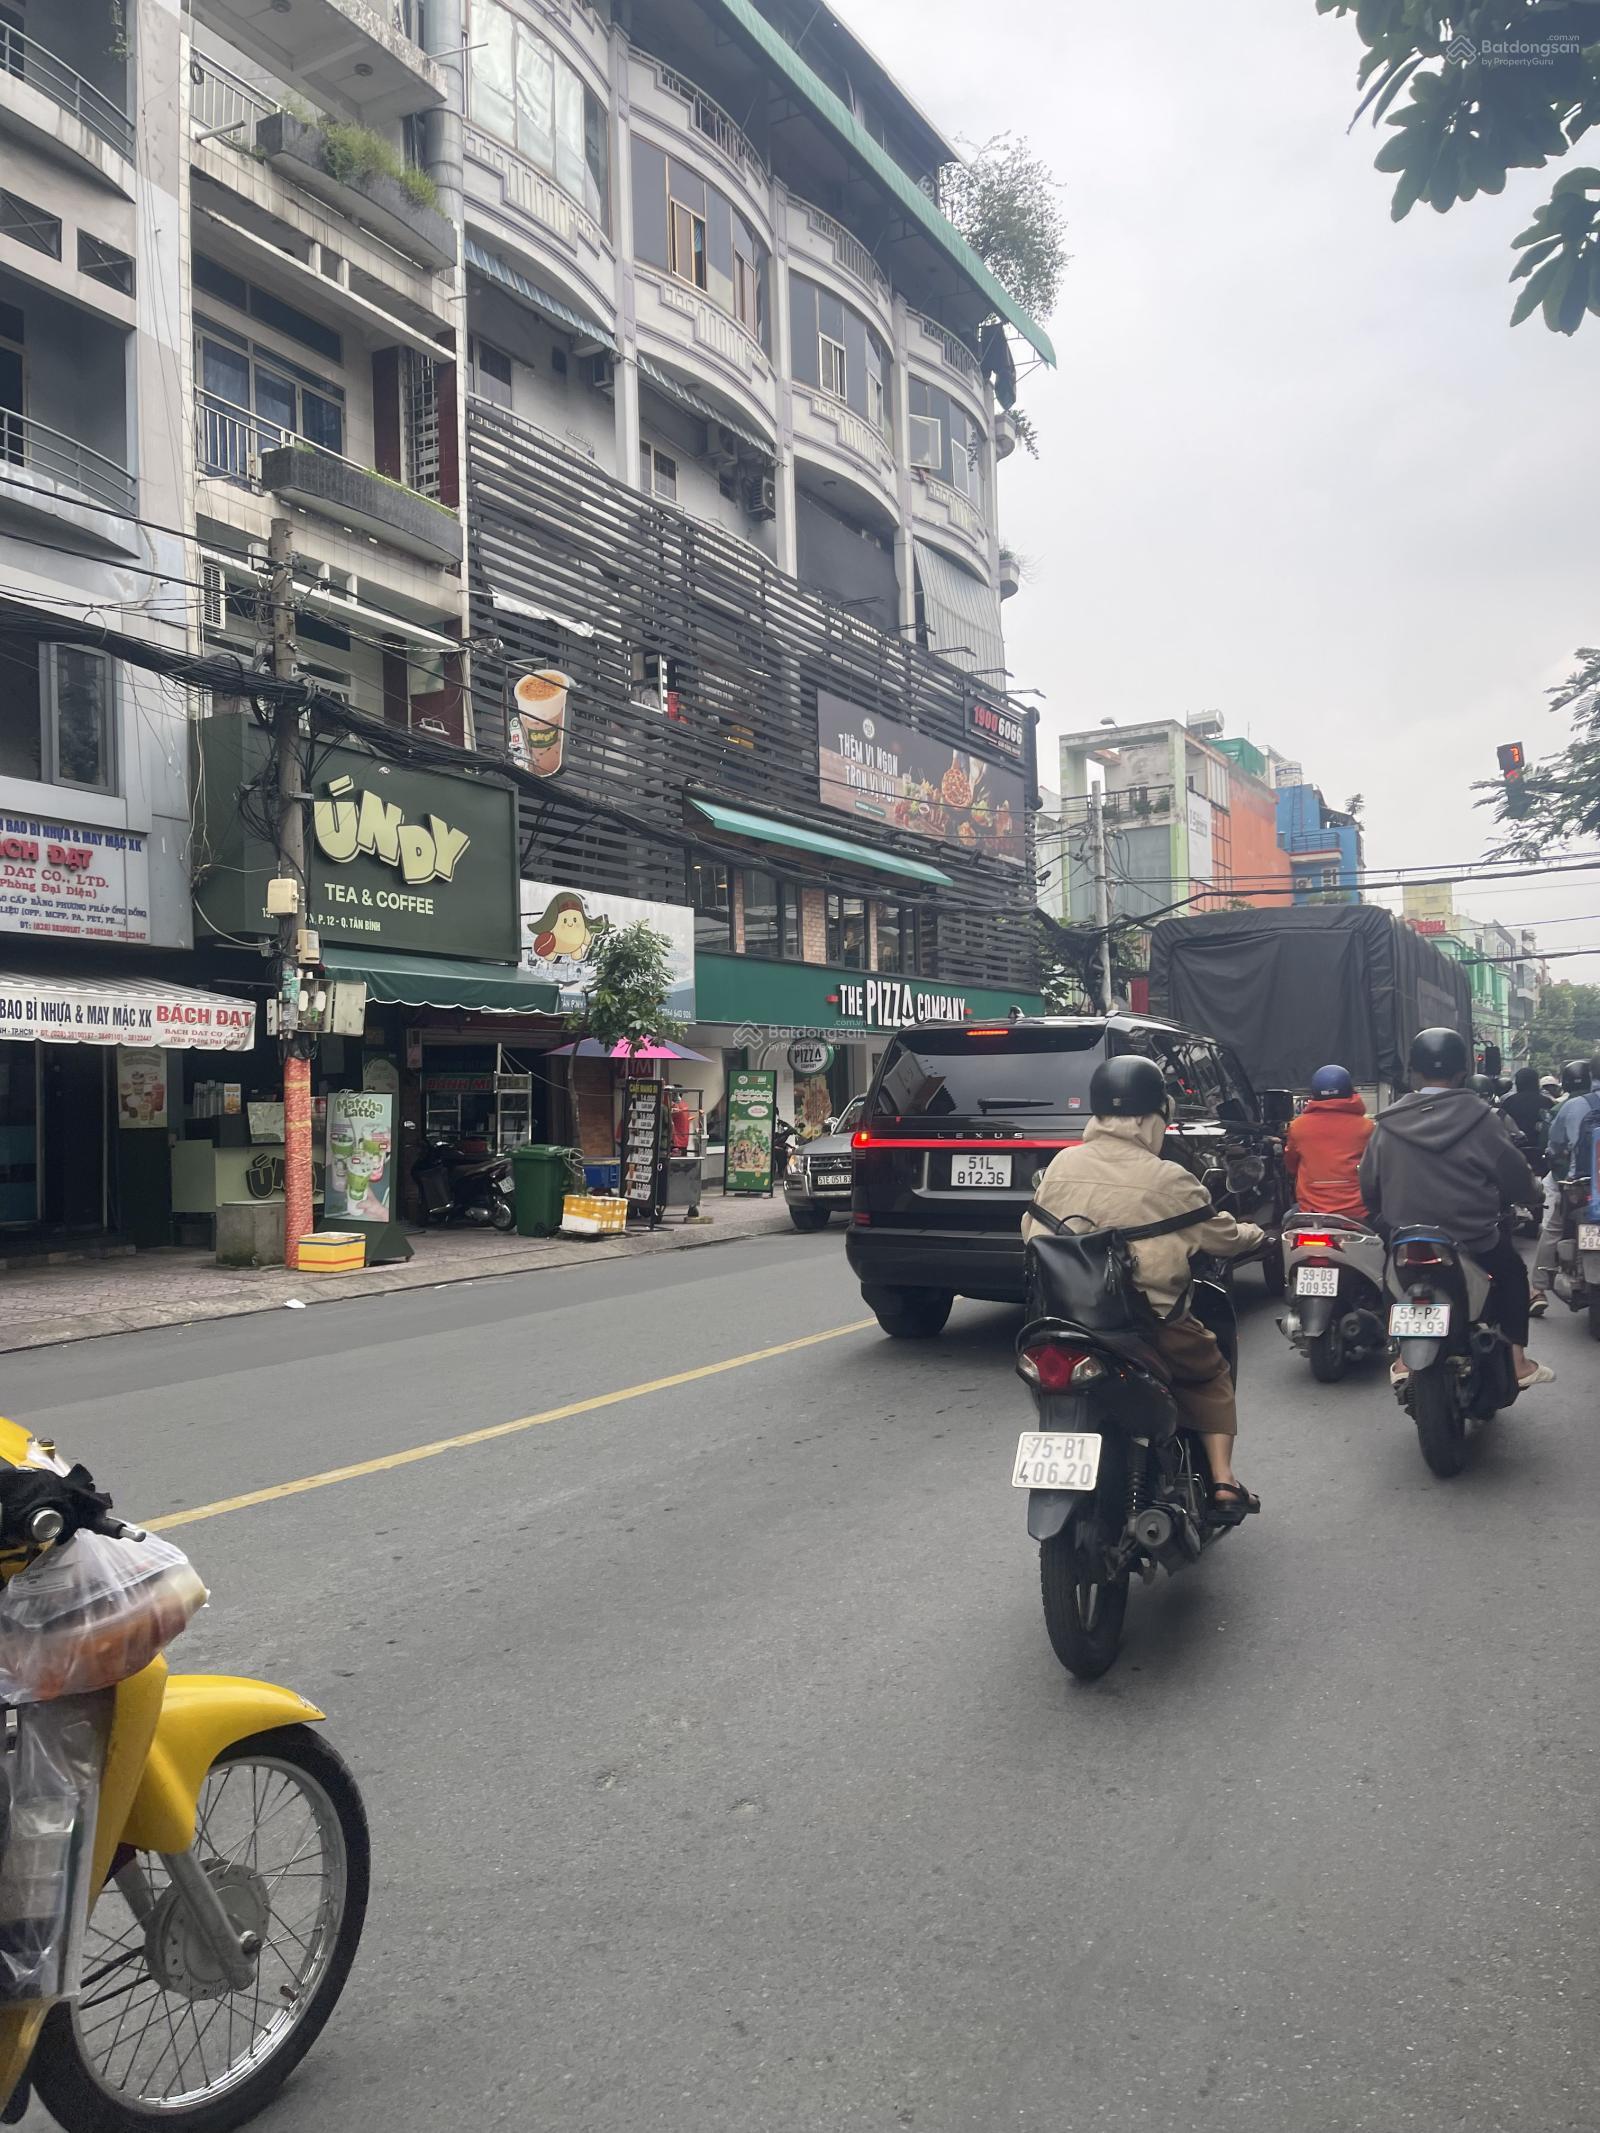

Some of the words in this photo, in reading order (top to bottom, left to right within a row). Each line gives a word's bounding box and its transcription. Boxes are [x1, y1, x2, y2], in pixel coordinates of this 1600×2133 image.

[838, 732, 863, 763] THÊM
[865, 743, 875, 773] VỊ
[877, 747, 898, 777] NGON
[6, 819, 28, 834] BAO
[30, 820, 41, 836] BÌ
[43, 824, 71, 842] NHỰA
[73, 830, 80, 842] &
[82, 831, 102, 846] MAY
[105, 834, 127, 851] MẶC
[129, 838, 142, 852] XK
[0, 833, 39, 861] CH
[47, 844, 93, 873] ĐẠT
[4, 865, 37, 879] DAT
[76, 874, 110, 889] LTD.
[41, 883, 62, 896] Đại
[66, 886, 98, 899] Diện)
[324, 882, 359, 904] TEA
[361, 888, 373, 906] &
[376, 890, 434, 915] COFFEE
[318, 913, 325, 925] P.
[326, 914, 335, 926] 12
[340, 917, 348, 929] Q.
[349, 916, 364, 930] TÂN
[365, 917, 381, 931] BÌNH
[840, 984, 863, 1016] THE
[866, 979, 915, 1027] PIZZA
[917, 992, 966, 1021] COMPANY
[0, 999, 22, 1019] BAO
[26, 997, 37, 1020] BÌ
[41, 1001, 71, 1027] NHỰA
[75, 1004, 84, 1024] &
[87, 1005, 110, 1025] MAY
[113, 1003, 136, 1030] MẶC
[139, 1009, 152, 1028] XK
[156, 1003, 211, 1025] BÁCH
[216, 1009, 253, 1031] ĐẠT
[794, 1048, 823, 1063] PIZZA
[337, 1098, 383, 1114] Matcha
[343, 1107, 376, 1119] Latte
[968, 1156, 994, 1170] 51L
[957, 1171, 1004, 1185] 812.36
[1302, 1269, 1333, 1282] 59-D3
[1299, 1281, 1335, 1296] 309.55
[1399, 1307, 1441, 1321] 59-P2
[1393, 1320, 1445, 1335] 613.93
[1030, 1437, 1085, 1461] 75-B1
